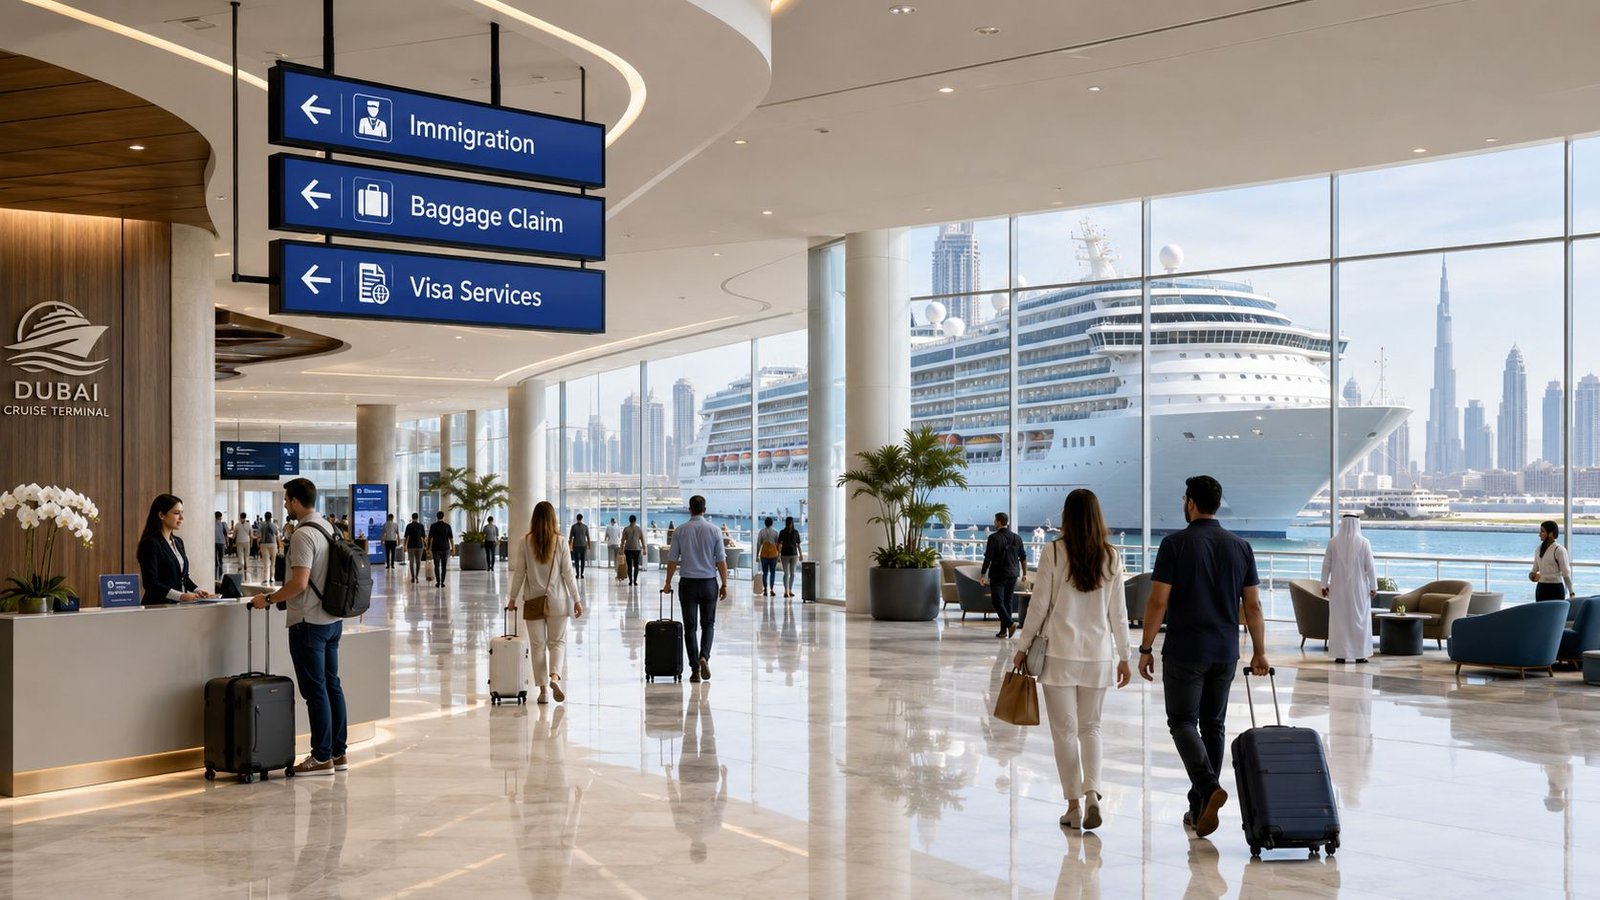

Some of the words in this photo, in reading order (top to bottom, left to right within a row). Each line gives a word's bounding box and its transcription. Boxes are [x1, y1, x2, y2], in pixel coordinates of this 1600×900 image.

[410, 114, 535, 154] Immigration
[411, 195, 502, 229] Baggage
[508, 207, 564, 233] Claim
[410, 276, 454, 300] Visa
[460, 280, 542, 307] Services
[15, 380, 98, 402] DUBAI
[4, 405, 47, 416] CRUISE
[51, 406, 110, 417] TERMINAL
